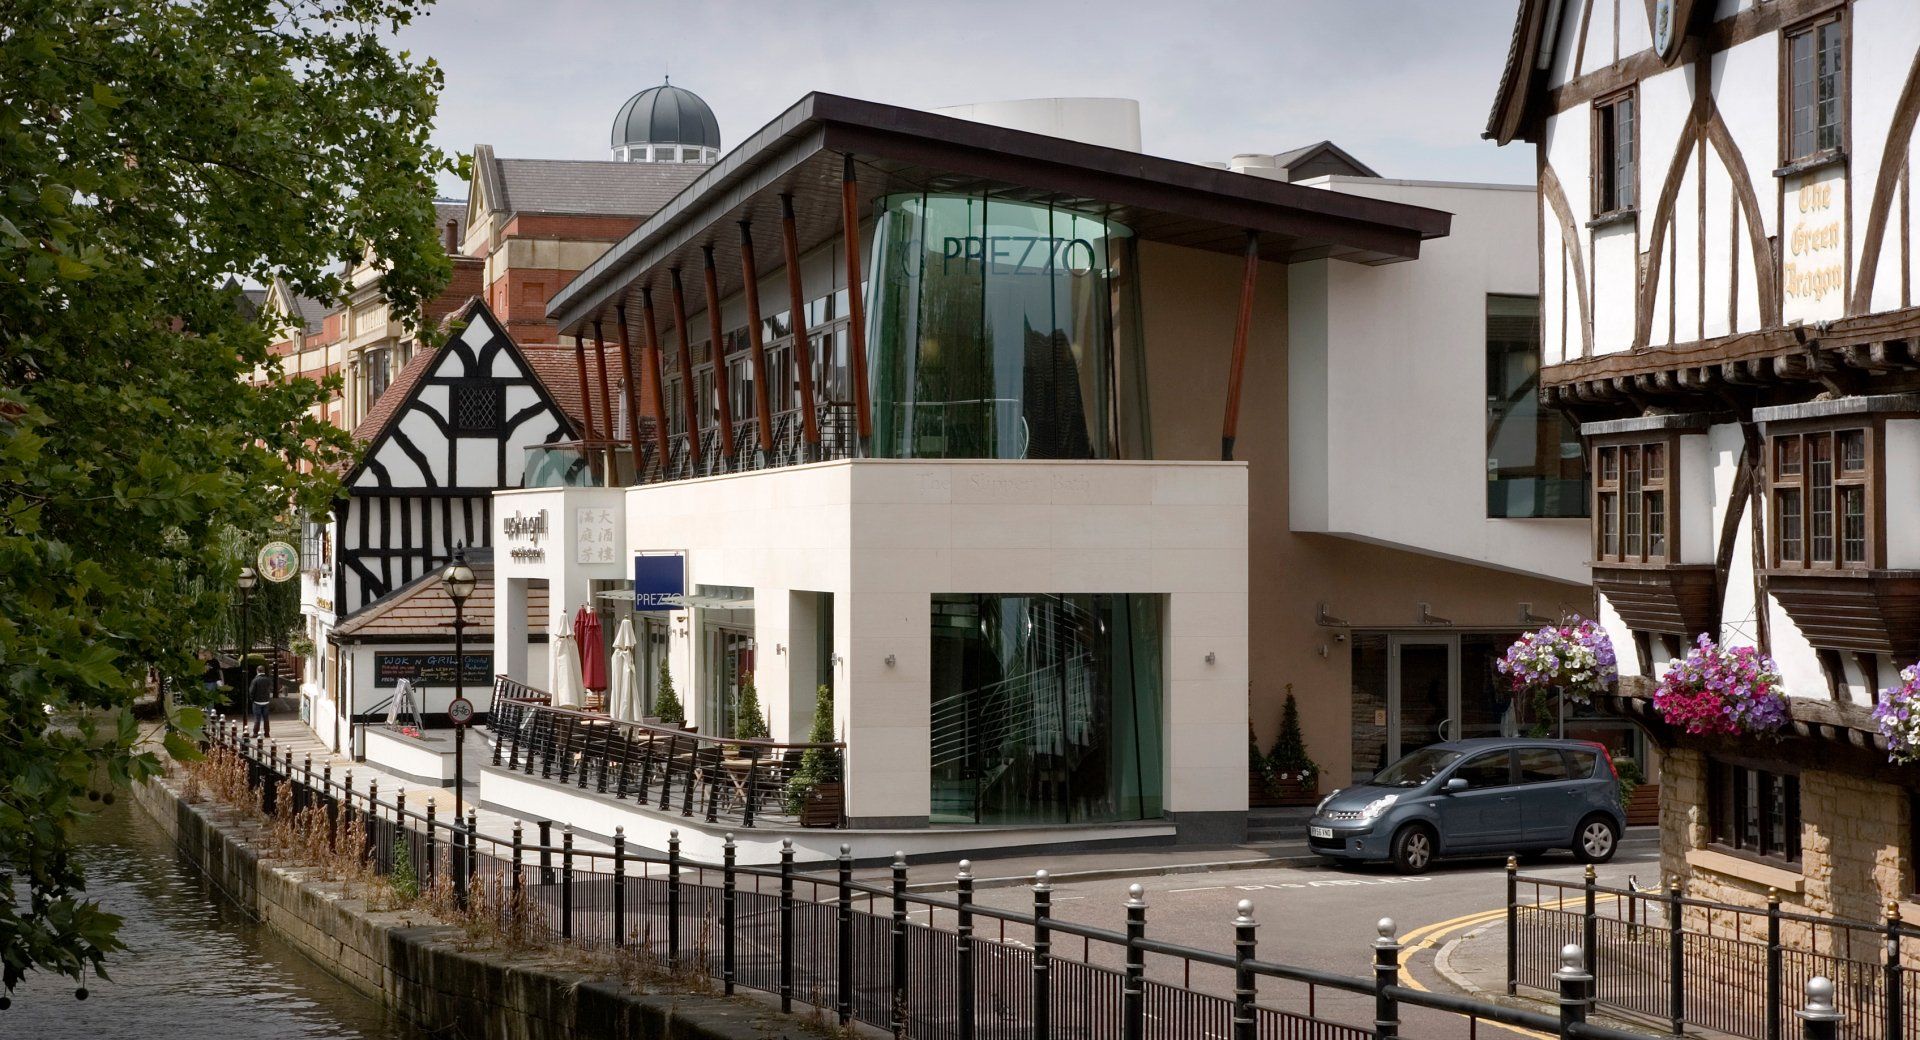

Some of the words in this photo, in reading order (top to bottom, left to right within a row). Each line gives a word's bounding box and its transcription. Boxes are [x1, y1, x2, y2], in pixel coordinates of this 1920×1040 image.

[1798, 180, 1832, 213] The
[1790, 219, 1840, 257] Green
[943, 236, 1095, 277] PREZZO
[1783, 261, 1842, 302] Dragon
[384, 657, 409, 665] WOK
[1234, 876, 1432, 891] DISABLED
